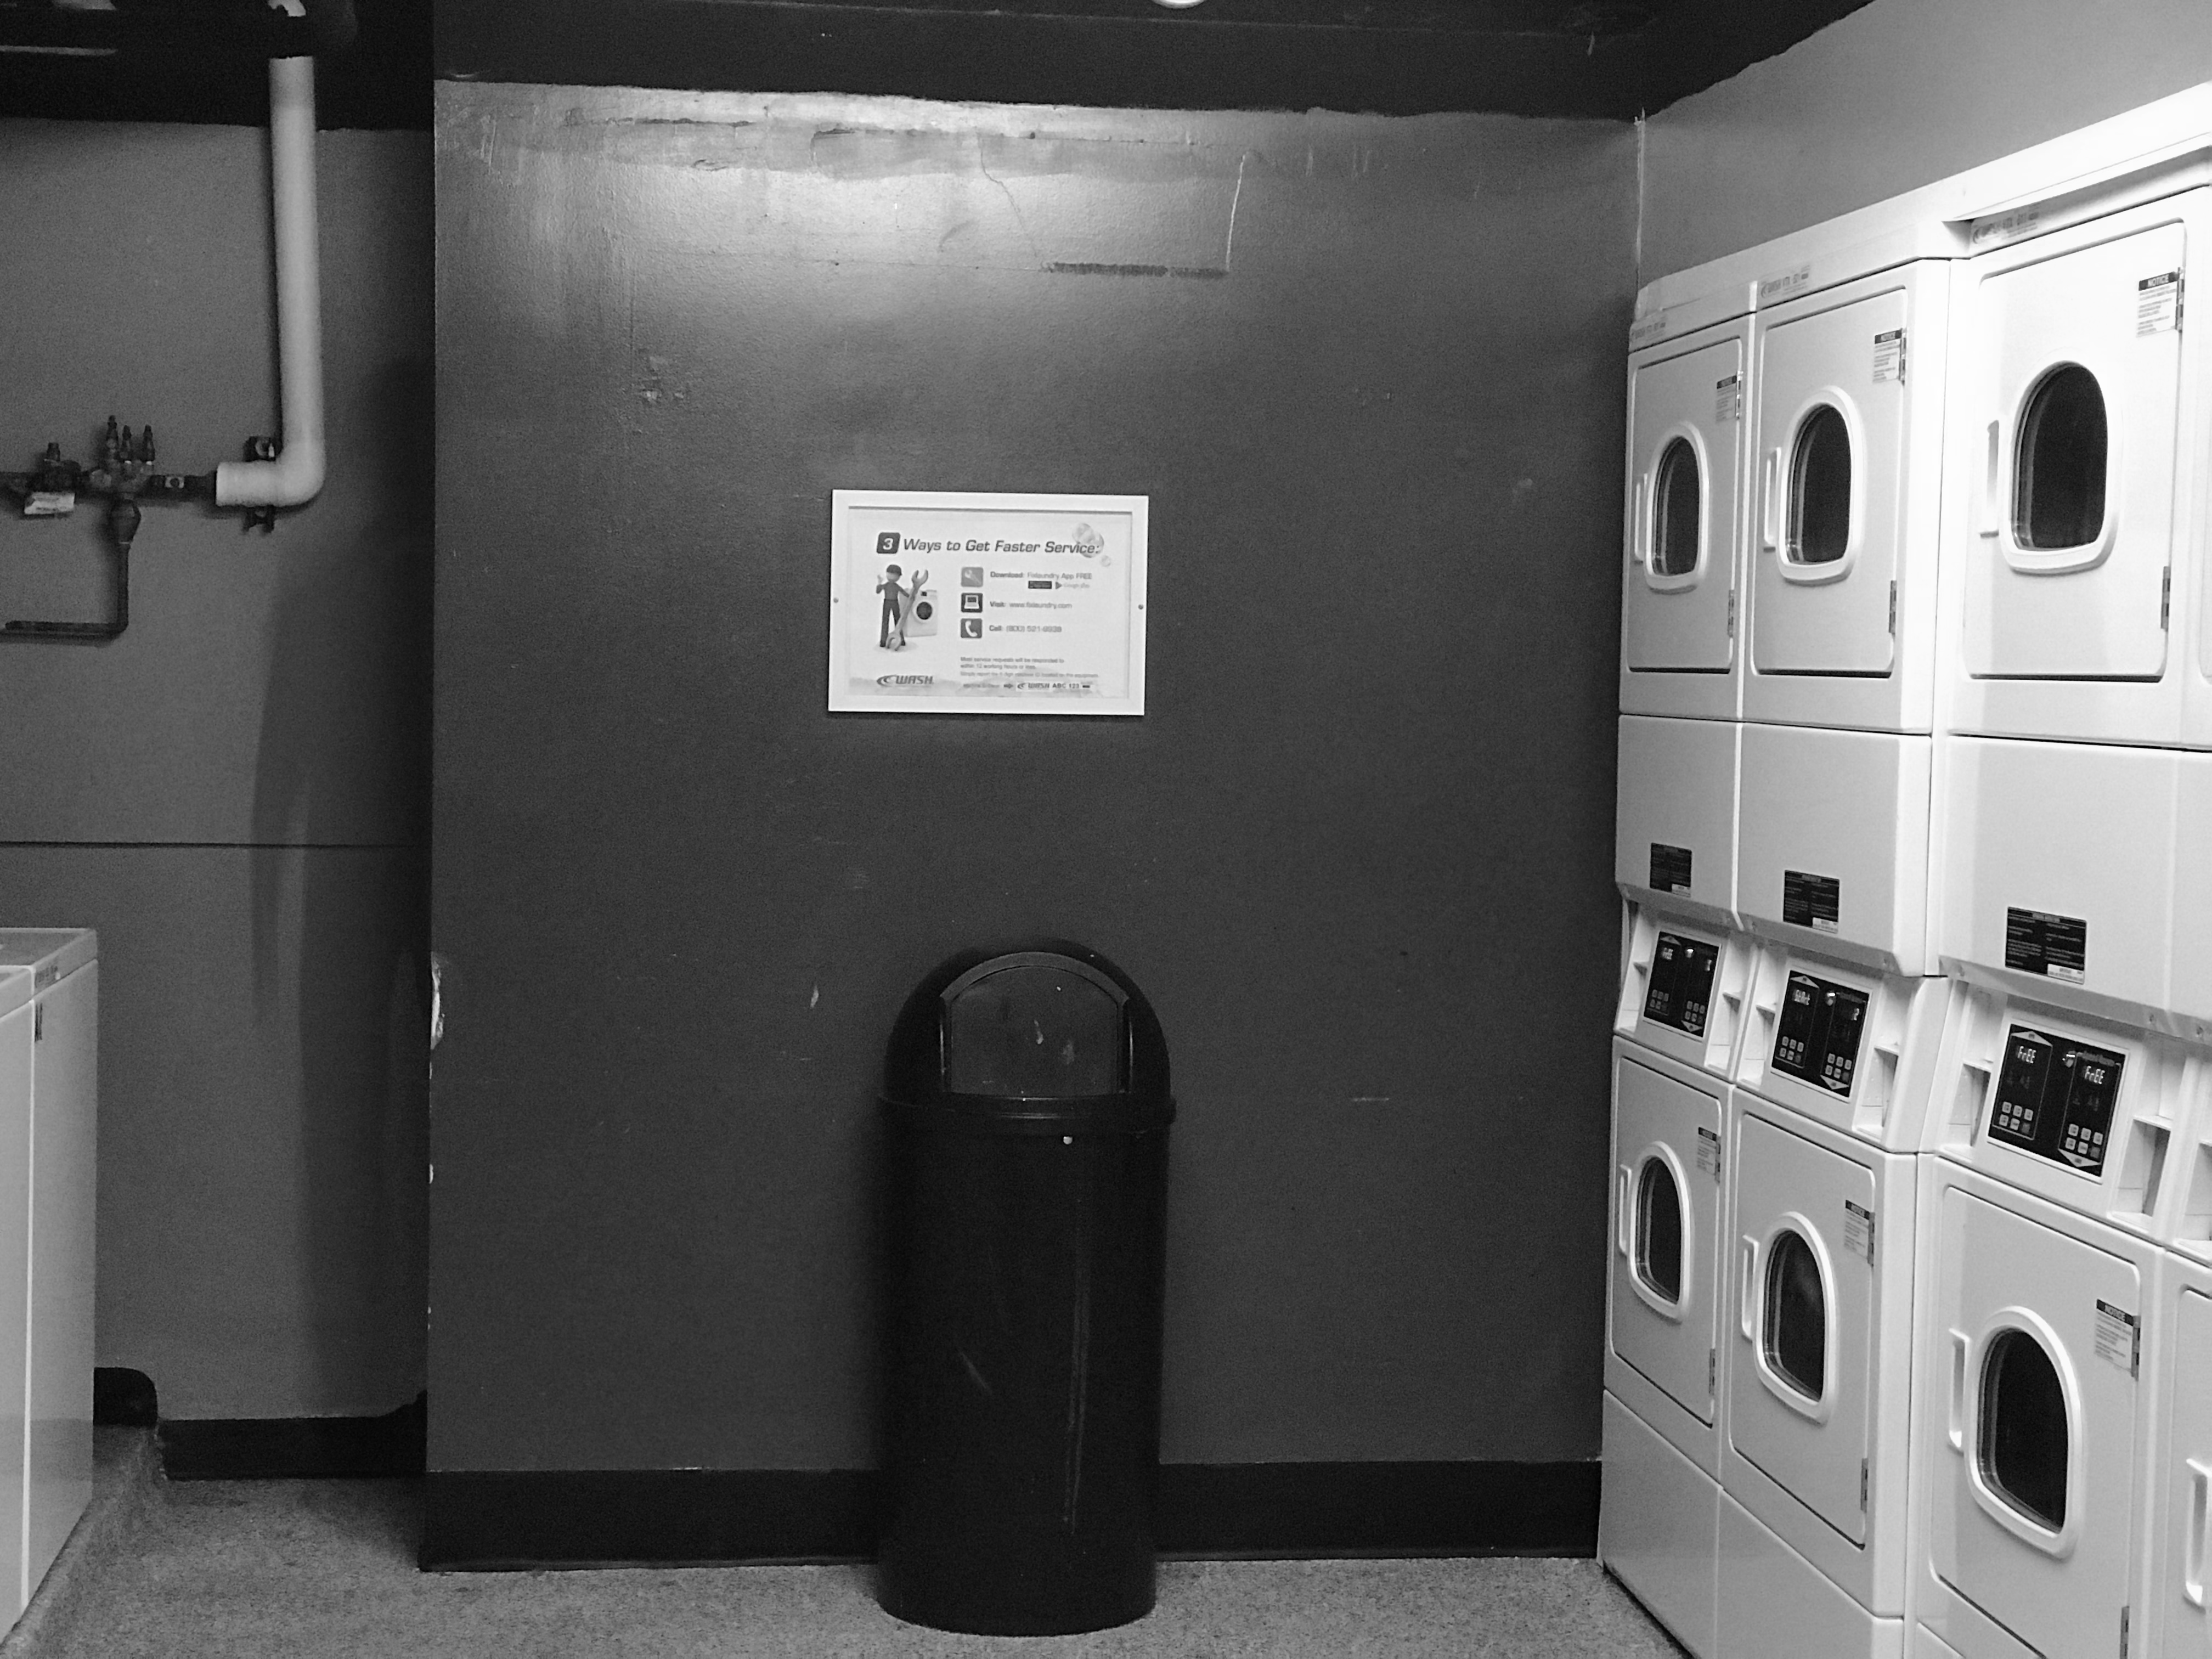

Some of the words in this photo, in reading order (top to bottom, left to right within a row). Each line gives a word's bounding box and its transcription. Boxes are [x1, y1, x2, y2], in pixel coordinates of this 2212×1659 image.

[883, 538, 894, 550] 3
[904, 538, 941, 554] Ways
[946, 540, 961, 551] to
[966, 539, 990, 551] Get
[995, 540, 1041, 552] Faster
[1044, 541, 1099, 554] Service:
